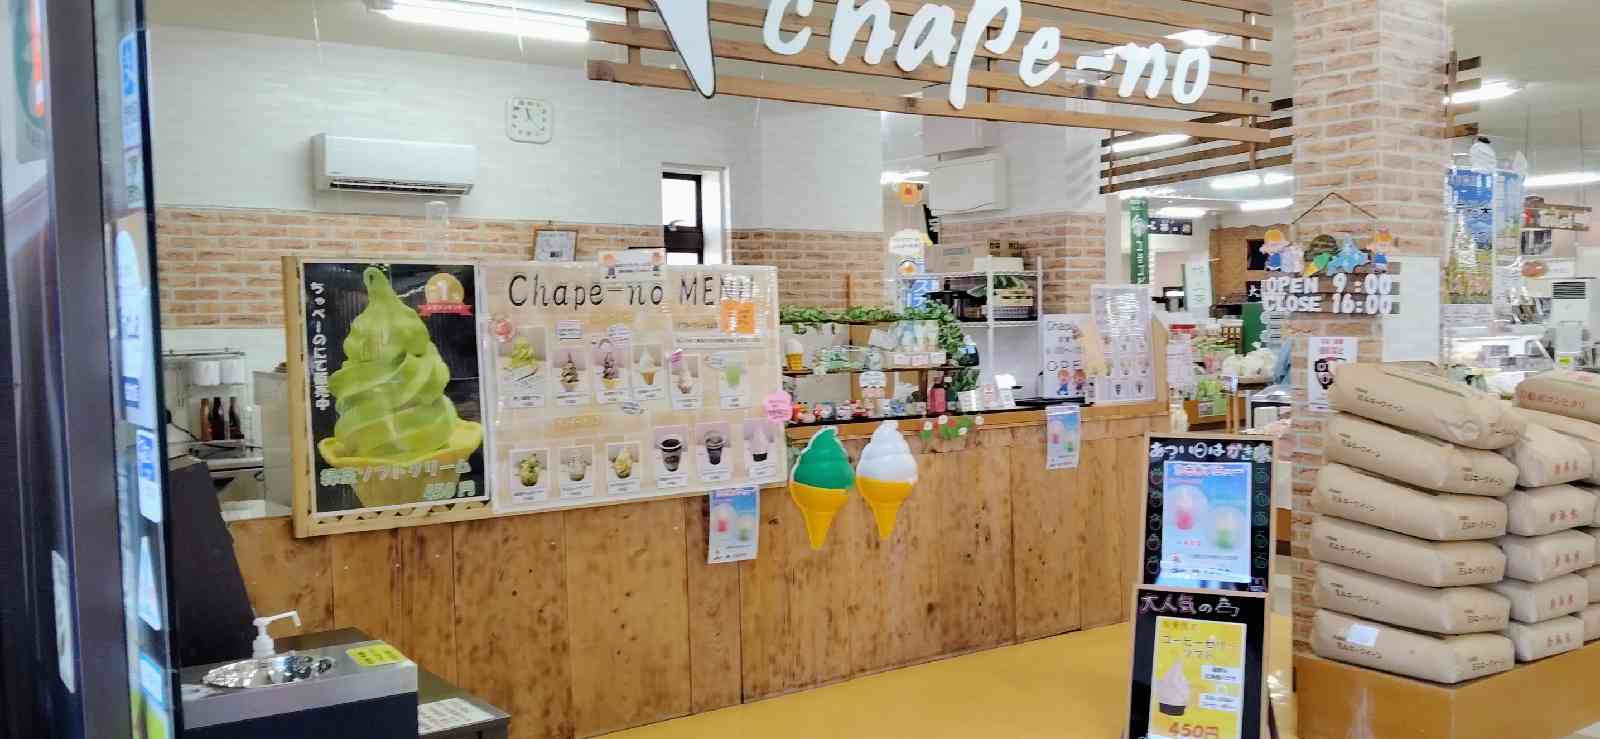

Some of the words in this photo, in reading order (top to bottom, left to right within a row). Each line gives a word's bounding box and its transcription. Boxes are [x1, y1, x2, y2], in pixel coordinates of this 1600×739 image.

[508, 273, 664, 310] Chape-no
[1266, 276, 1320, 294] OPEN
[1262, 294, 1322, 312] CLOSE
[1332, 293, 1393, 314] 16:00
